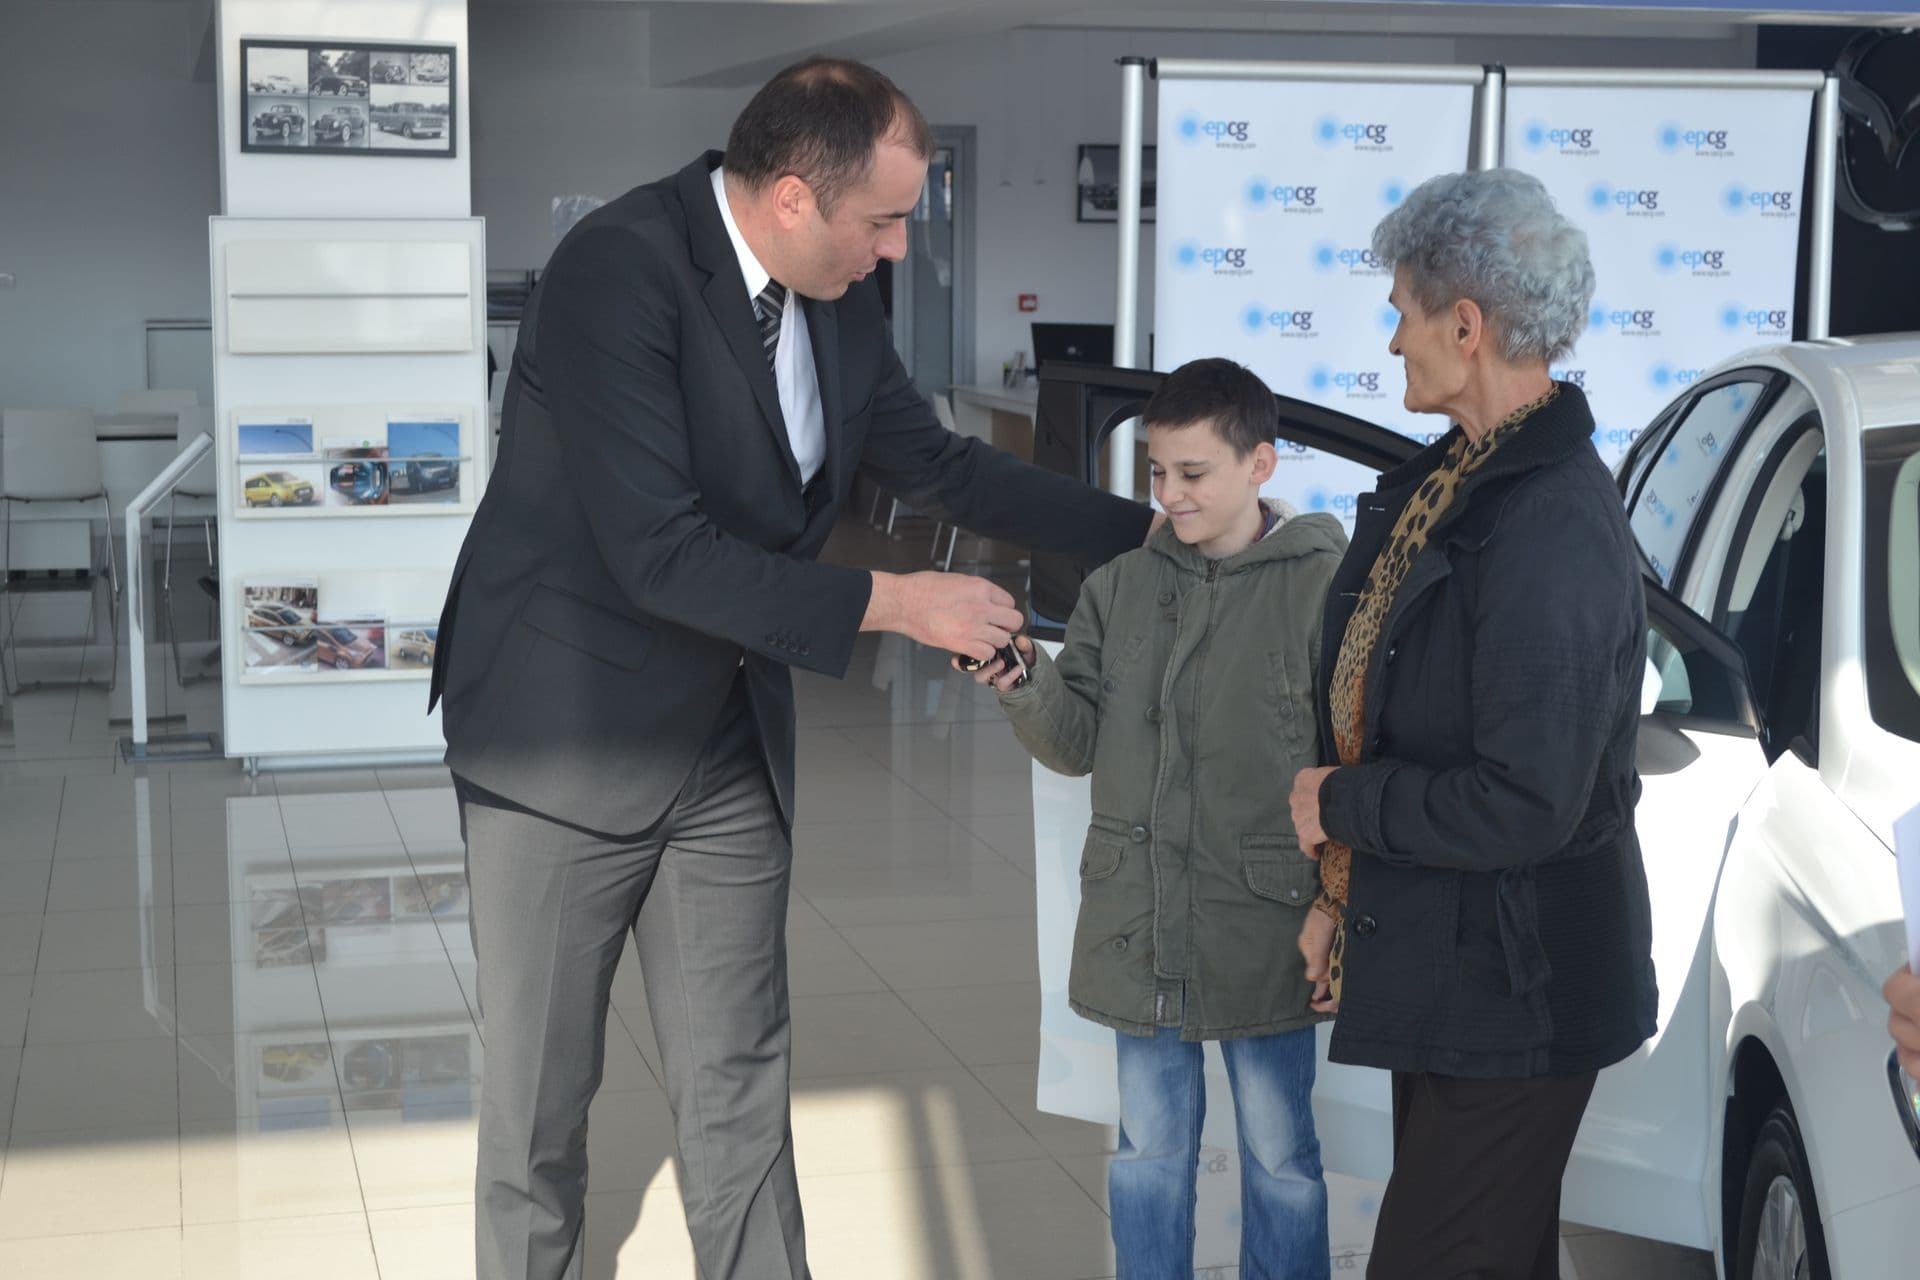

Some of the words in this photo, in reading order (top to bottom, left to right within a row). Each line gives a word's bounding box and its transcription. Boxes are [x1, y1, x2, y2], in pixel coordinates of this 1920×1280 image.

[1205, 121, 1249, 141] epcg
[1344, 124, 1387, 144] epcg
[1550, 127, 1593, 148] epcg
[1685, 129, 1728, 149] epcg
[1273, 185, 1316, 206] epcg
[1616, 189, 1659, 209] epcg
[1750, 190, 1792, 210] epcg
[1203, 247, 1246, 267] epcg
[1682, 249, 1724, 269] epcg
[1271, 309, 1312, 330] epcg
[1612, 309, 1655, 329] epcg
[1746, 309, 1787, 329] epcg
[1335, 370, 1379, 391] epcg
